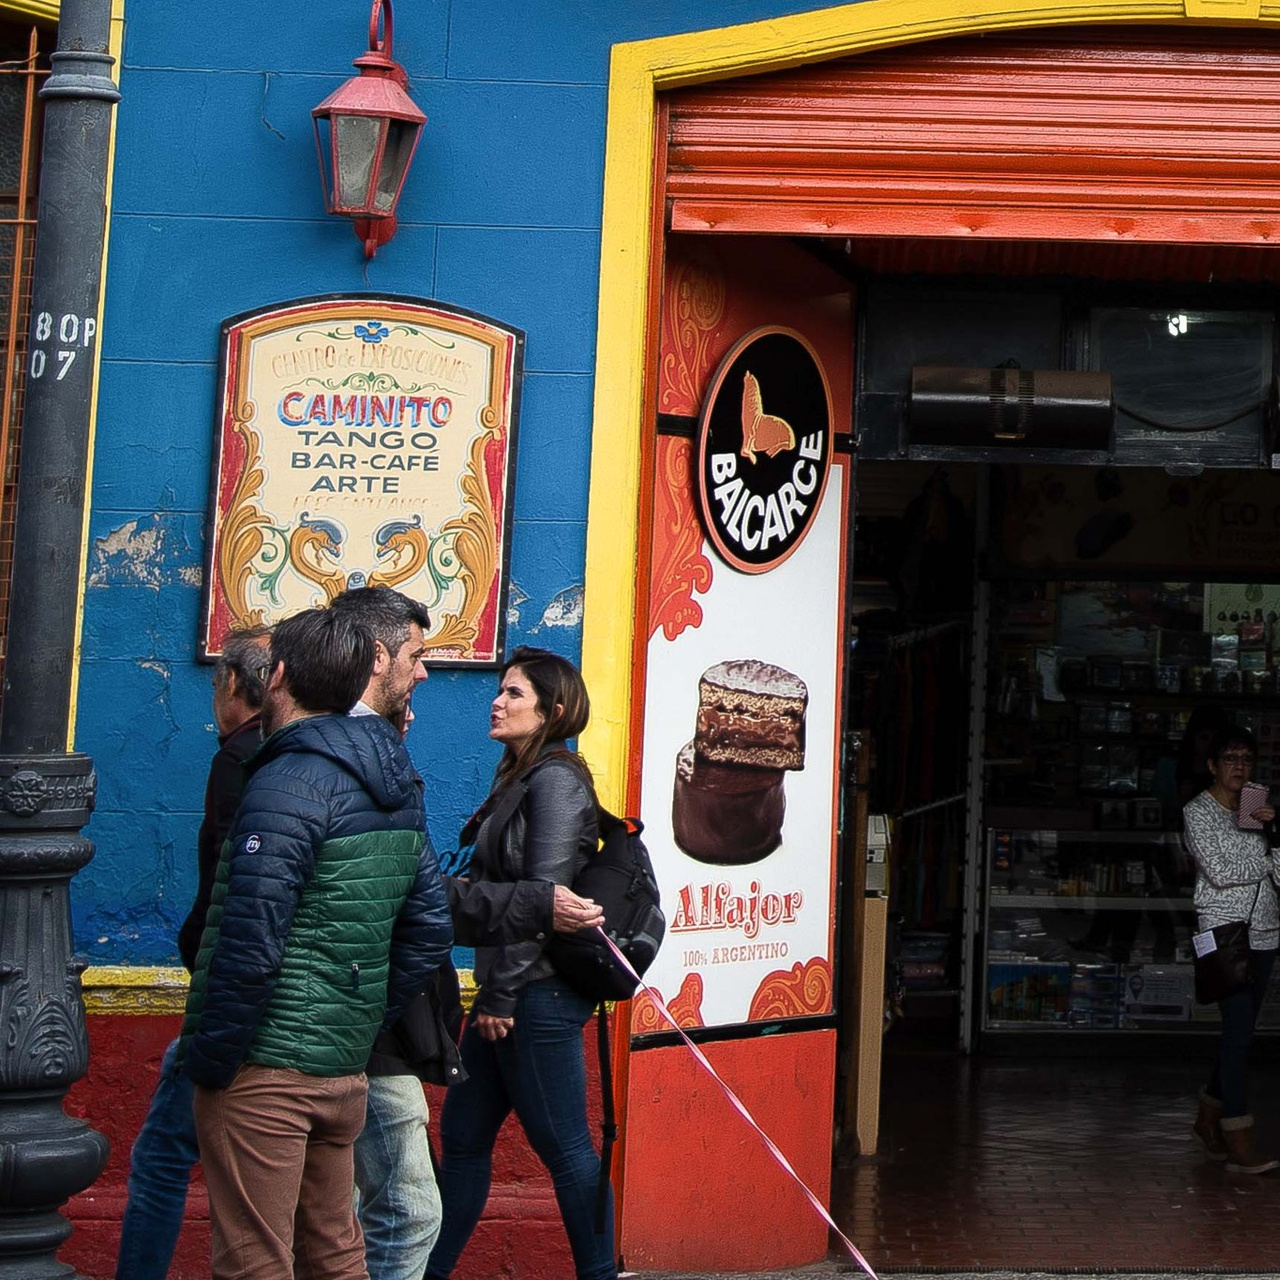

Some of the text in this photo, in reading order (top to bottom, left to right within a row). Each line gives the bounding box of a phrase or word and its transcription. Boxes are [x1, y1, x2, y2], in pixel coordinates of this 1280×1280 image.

[277, 391, 453, 428] CAMINITO
[298, 430, 437, 450] TANGO
[291, 449, 440, 471] BAR-CAFÉ
[309, 476, 399, 493] ARTE
[712, 430, 823, 551] BALCARCE
[670, 879, 803, 938] Alfajor
[683, 942, 788, 967] 100% ARGENTINO
